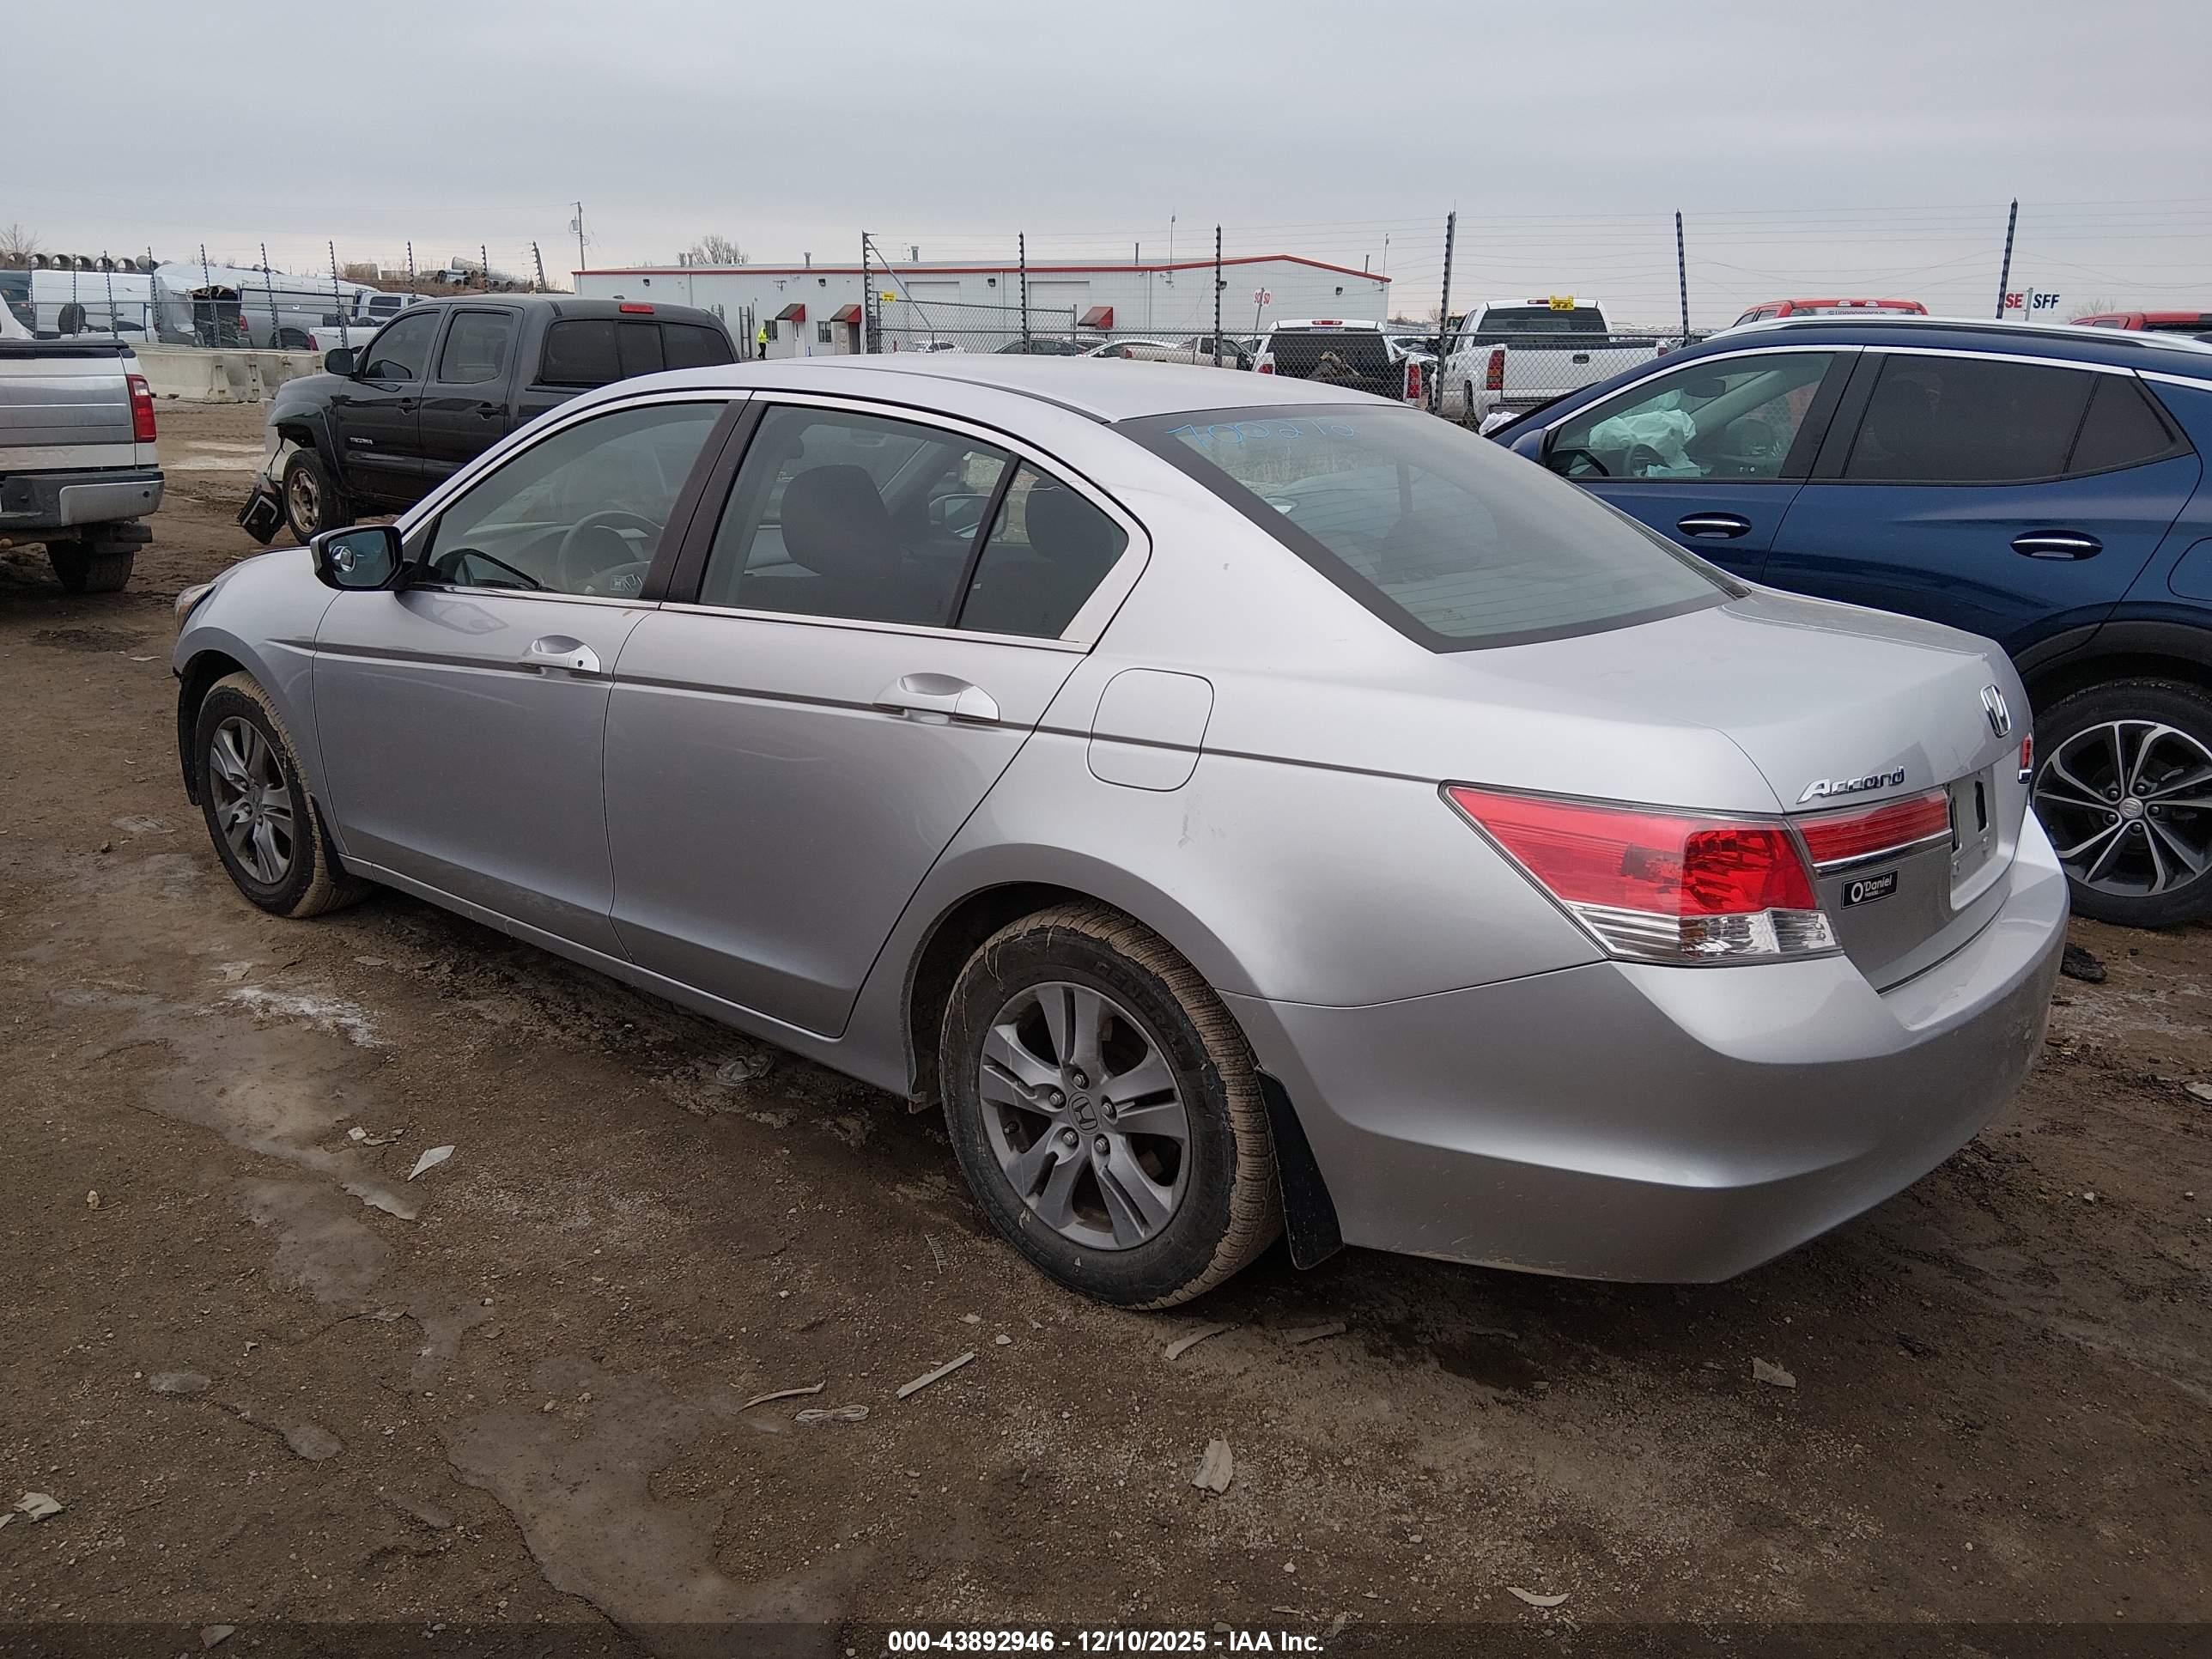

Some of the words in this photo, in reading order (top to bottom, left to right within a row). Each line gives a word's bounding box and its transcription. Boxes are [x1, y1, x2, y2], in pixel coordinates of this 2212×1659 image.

[2005, 293, 2024, 308] SE
[2033, 294, 2060, 309] SFF
[1796, 766, 1904, 805] Accord
[1850, 874, 1893, 902] O'Daniel
